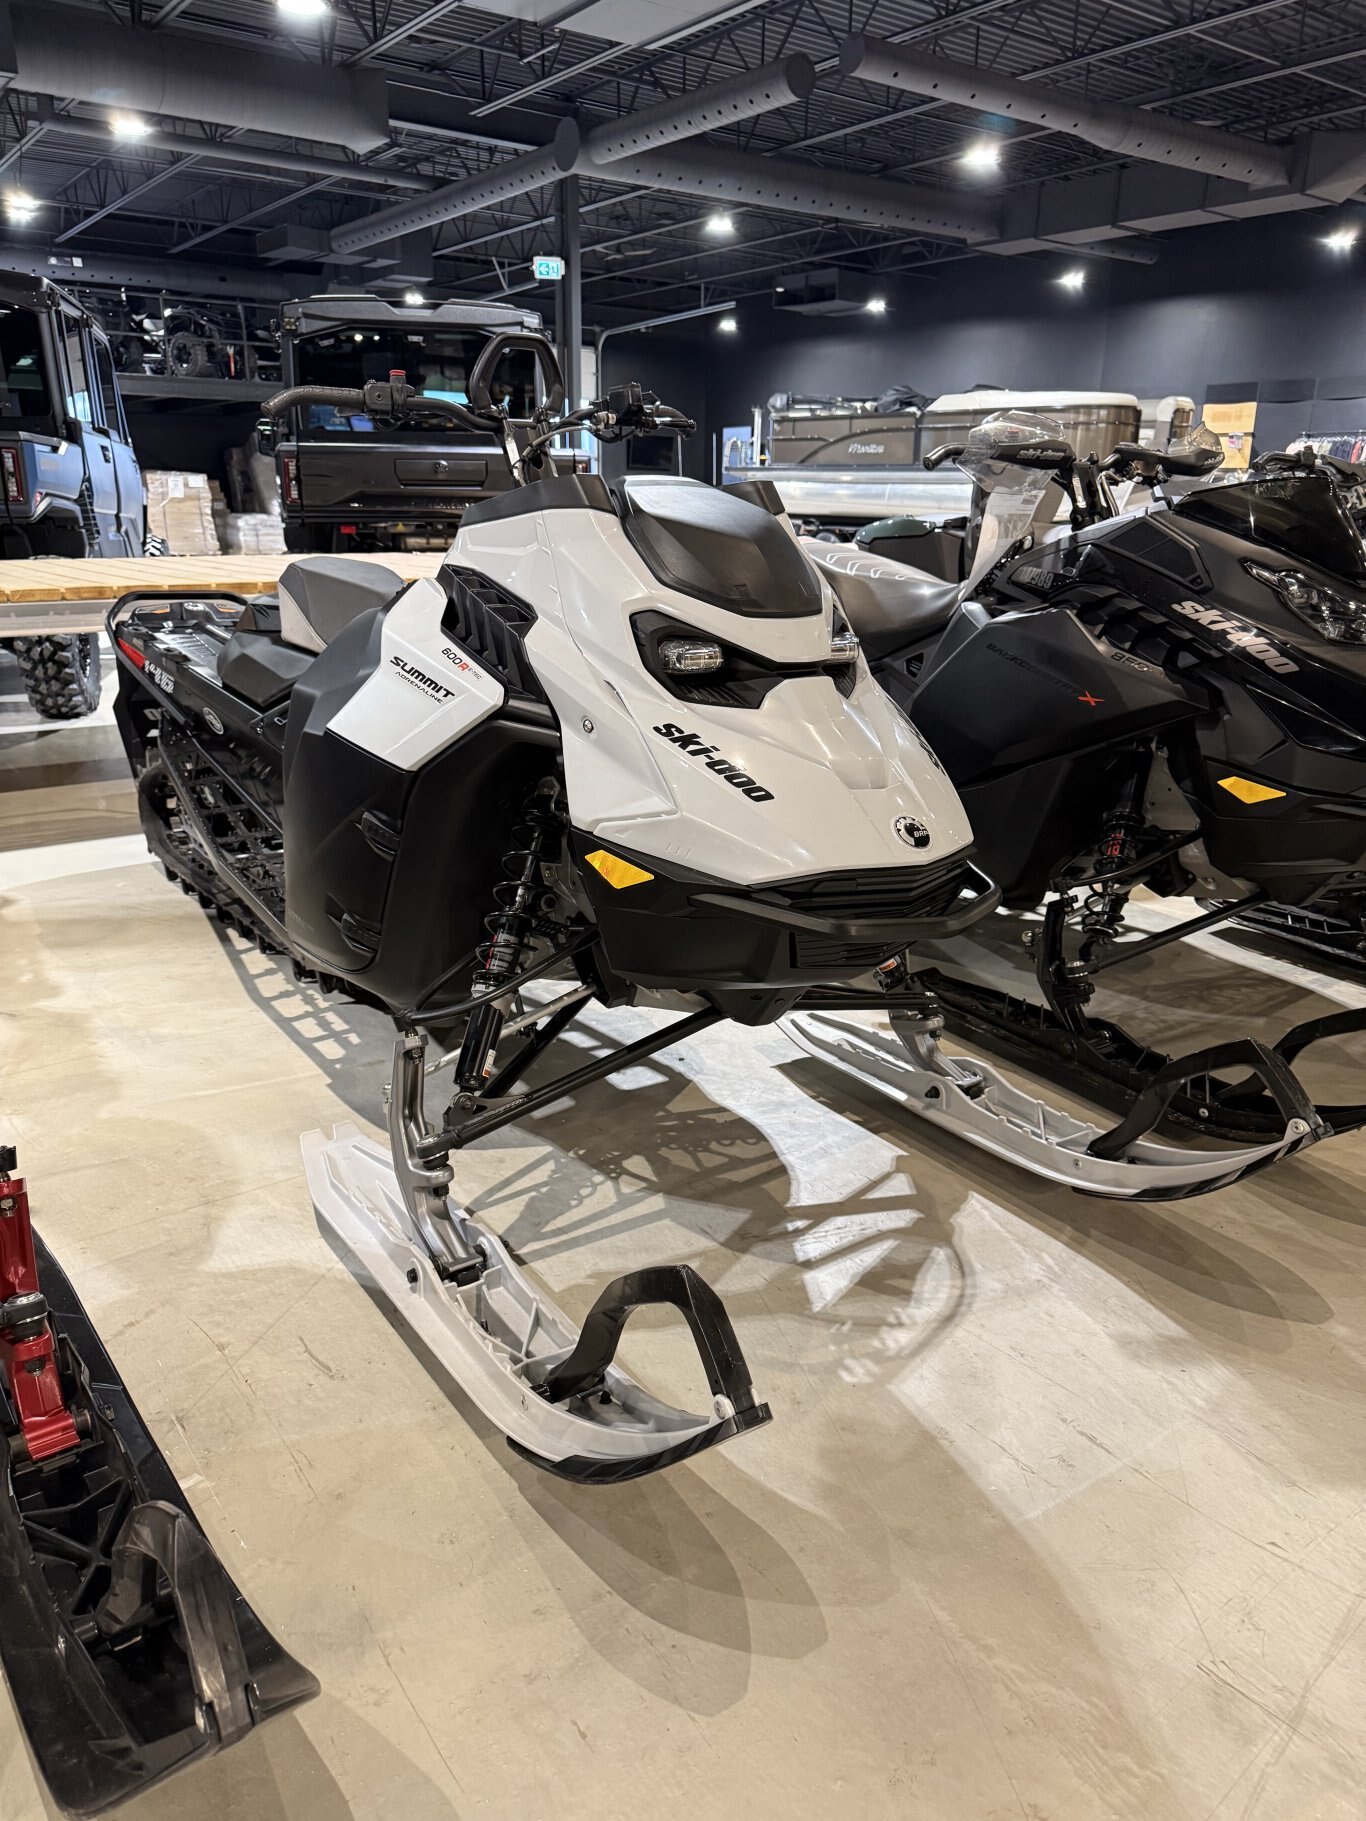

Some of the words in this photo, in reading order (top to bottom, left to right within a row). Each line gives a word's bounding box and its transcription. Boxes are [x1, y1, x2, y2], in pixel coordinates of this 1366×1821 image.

[1171, 600, 1300, 674] ski-doo
[389, 656, 455, 698] SUMMIT
[441, 647, 470, 672] 600R
[395, 671, 443, 704] ADRENALINE
[652, 723, 775, 803] ski-doo
[913, 830, 929, 838] BRP
